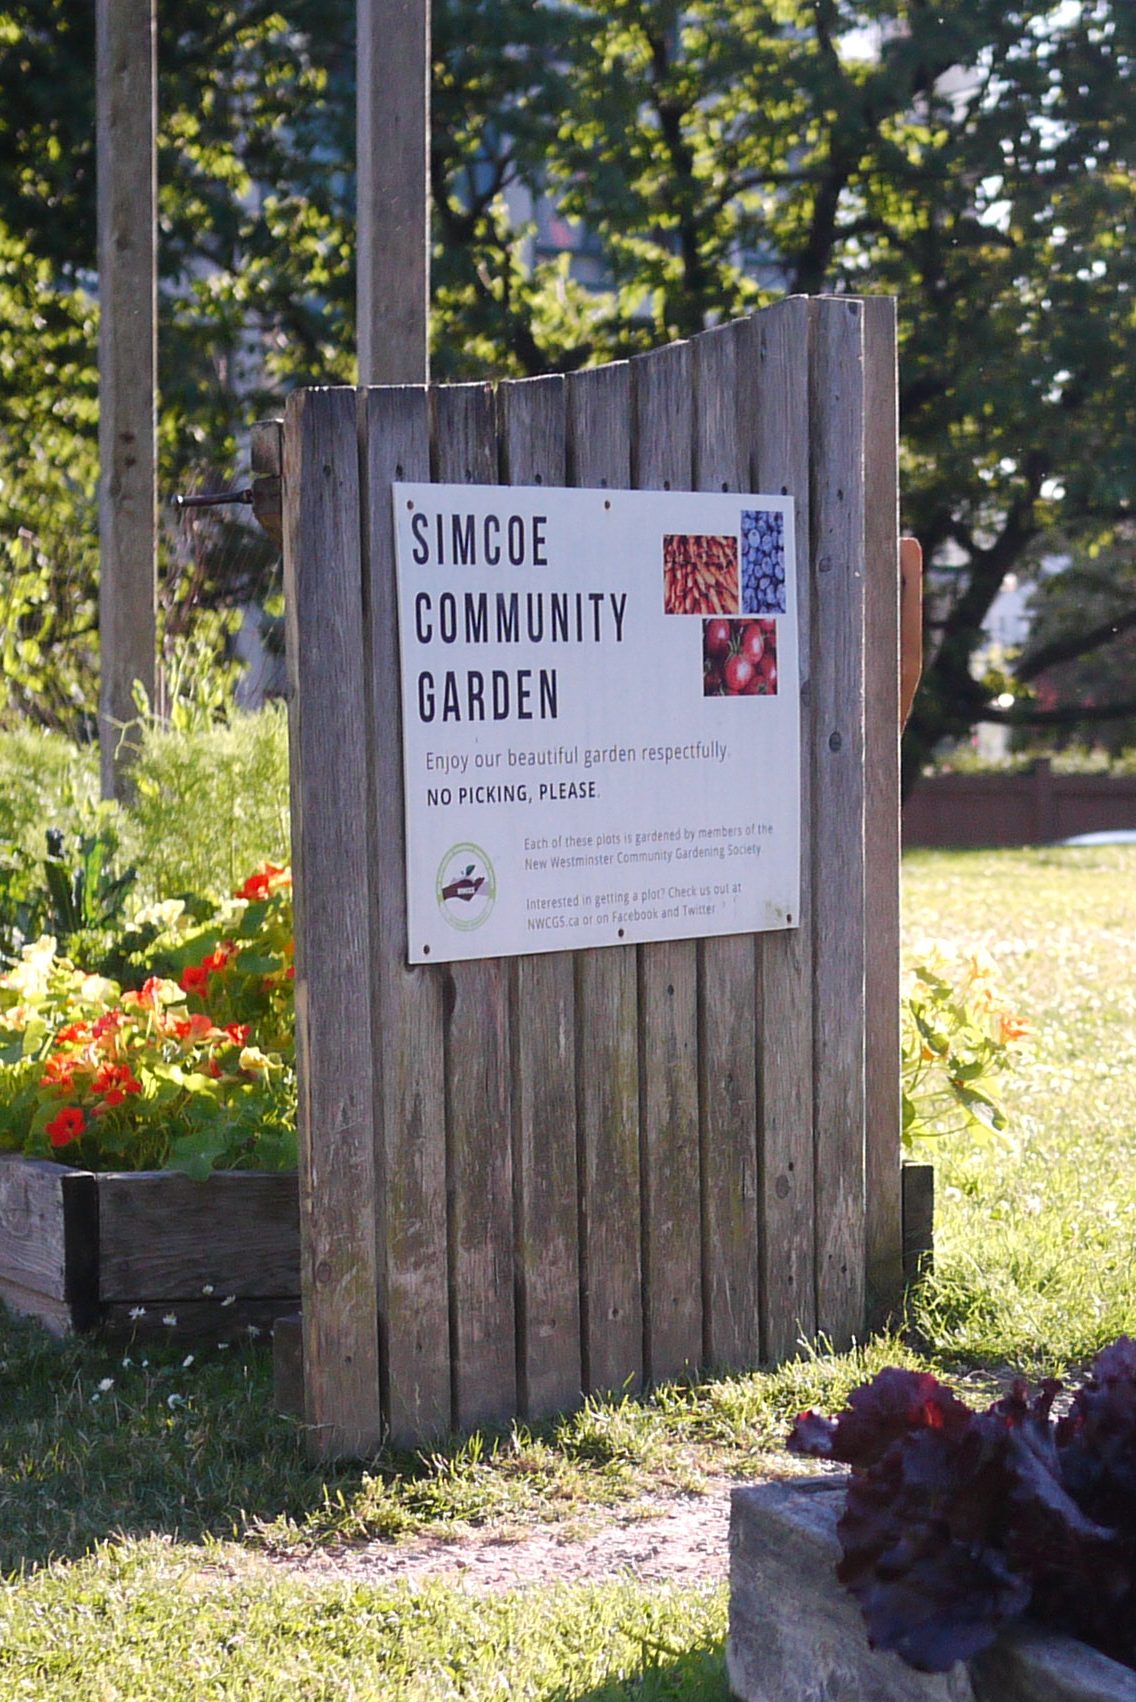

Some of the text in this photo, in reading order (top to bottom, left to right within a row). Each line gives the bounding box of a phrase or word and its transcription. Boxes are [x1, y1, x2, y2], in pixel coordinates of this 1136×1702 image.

[411, 513, 548, 566] SIMCOE
[415, 592, 627, 644] COMMUNITY
[418, 669, 558, 723] GARDEN
[426, 751, 469, 775] Enjoy
[474, 753, 502, 768] our
[507, 745, 578, 767] beautiful
[584, 744, 636, 768] garden
[427, 788, 452, 806] NO
[459, 784, 532, 805] PICKING,
[524, 823, 774, 850] Each of these plots is gardened by members of the
[524, 857, 548, 870] New
[550, 855, 614, 868] Westminster
[616, 849, 673, 864] Community
[675, 845, 725, 859] Gardening
[526, 882, 742, 910] Interested in getting a plot? Check us out at
[527, 914, 580, 930] NWCGS.ca
[582, 914, 593, 926] or
[596, 913, 609, 924] on
[611, 908, 659, 922] Facebook
[661, 905, 680, 918] and
